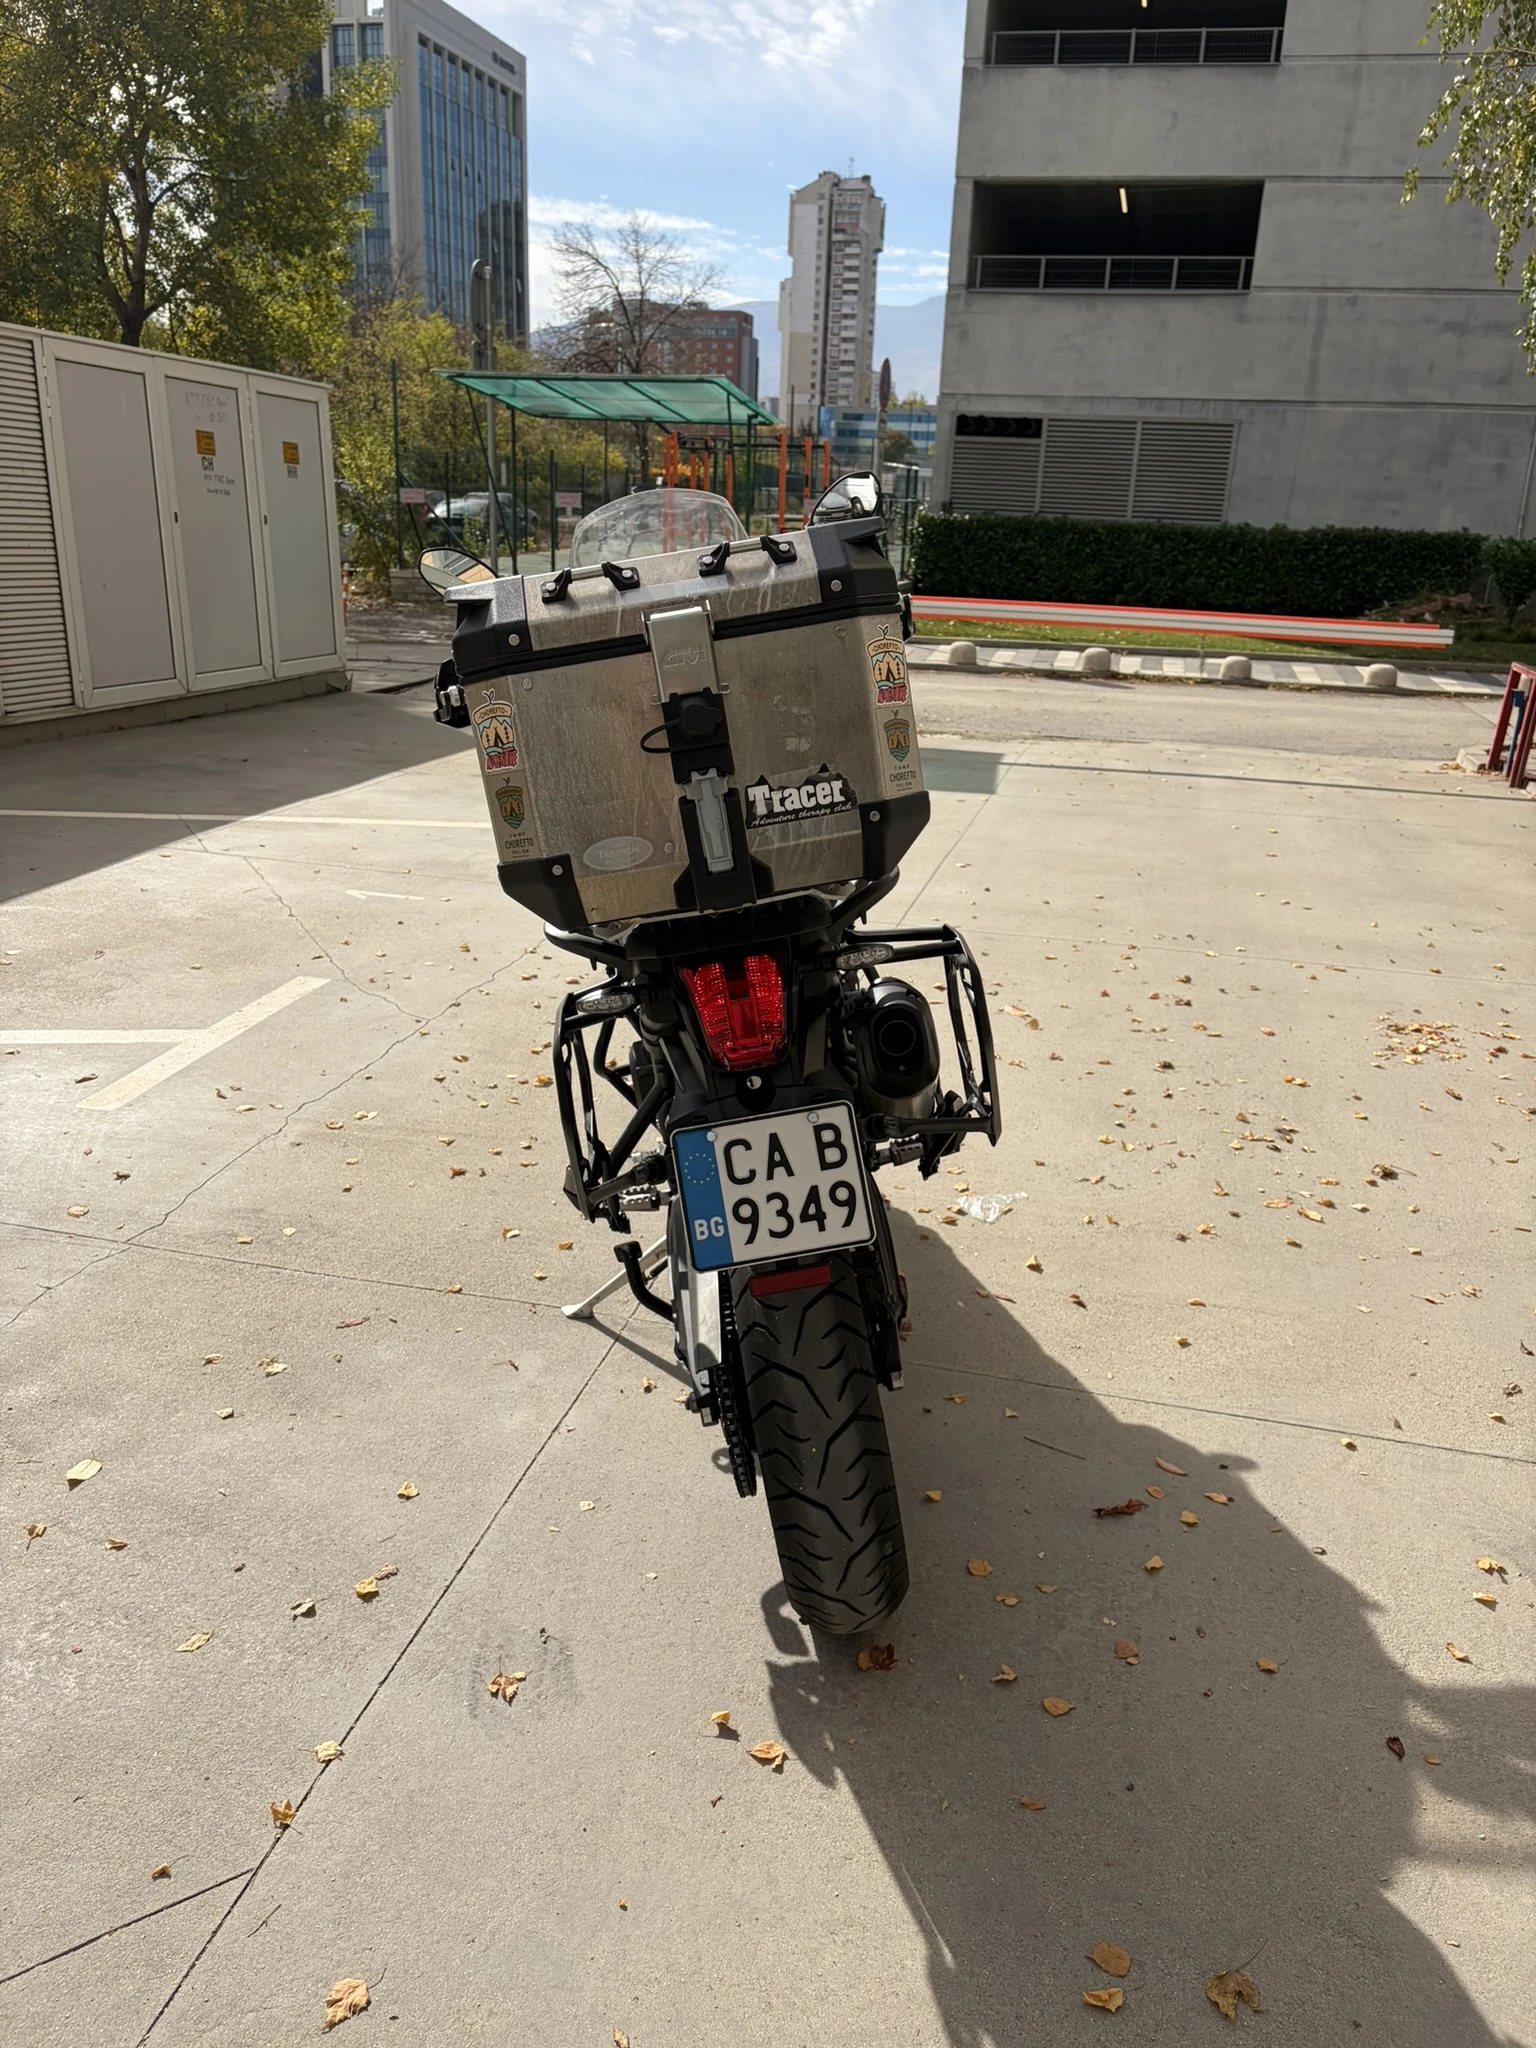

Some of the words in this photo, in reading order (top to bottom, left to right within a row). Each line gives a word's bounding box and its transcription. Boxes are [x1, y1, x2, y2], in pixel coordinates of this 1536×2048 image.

[662, 644, 707, 668] GIVI
[873, 642, 899, 653] CHOREFTO
[480, 707, 506, 720] CHOREFTO
[889, 770, 917, 782] CHOREFTO
[747, 780, 846, 816] Tracer
[751, 814, 796, 827] Adventure
[798, 807, 831, 818] therapy
[834, 801, 852, 812] club
[504, 838, 534, 850] CHOREFTO
[596, 845, 640, 859] TRIUMPH
[723, 1132, 795, 1185] CA
[813, 1123, 848, 1171] B
[732, 1180, 857, 1246] 9349
[694, 1216, 725, 1241] BG
